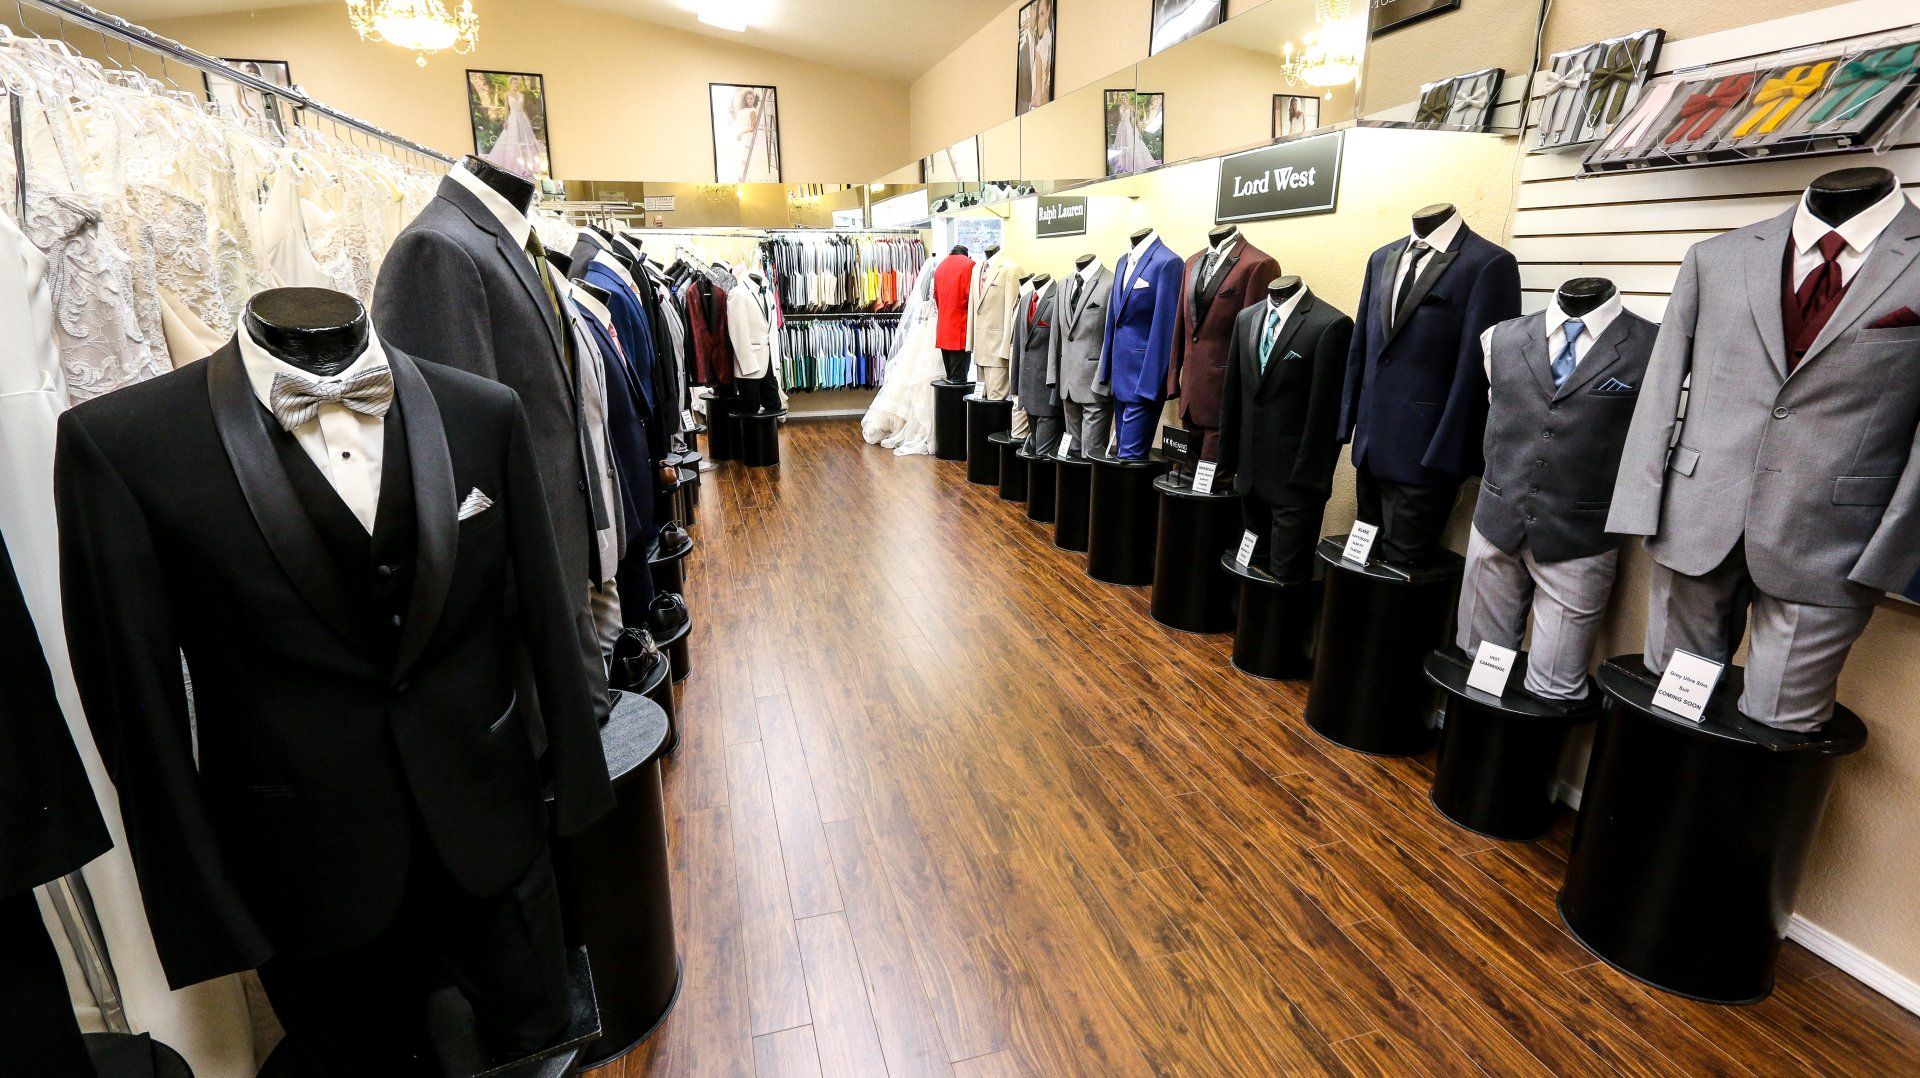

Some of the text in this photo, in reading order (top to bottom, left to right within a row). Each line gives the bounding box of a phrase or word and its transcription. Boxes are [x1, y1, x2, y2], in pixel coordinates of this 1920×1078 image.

[1233, 166, 1317, 197] Lord West
[1038, 203, 1084, 225] Ralph Lauren
[1479, 659, 1505, 672] CAMBRIDGE
[1670, 670, 1708, 689] Grey Ultra Slim
[1678, 685, 1690, 693] Suit
[1658, 689, 1702, 710] COMING SOON
